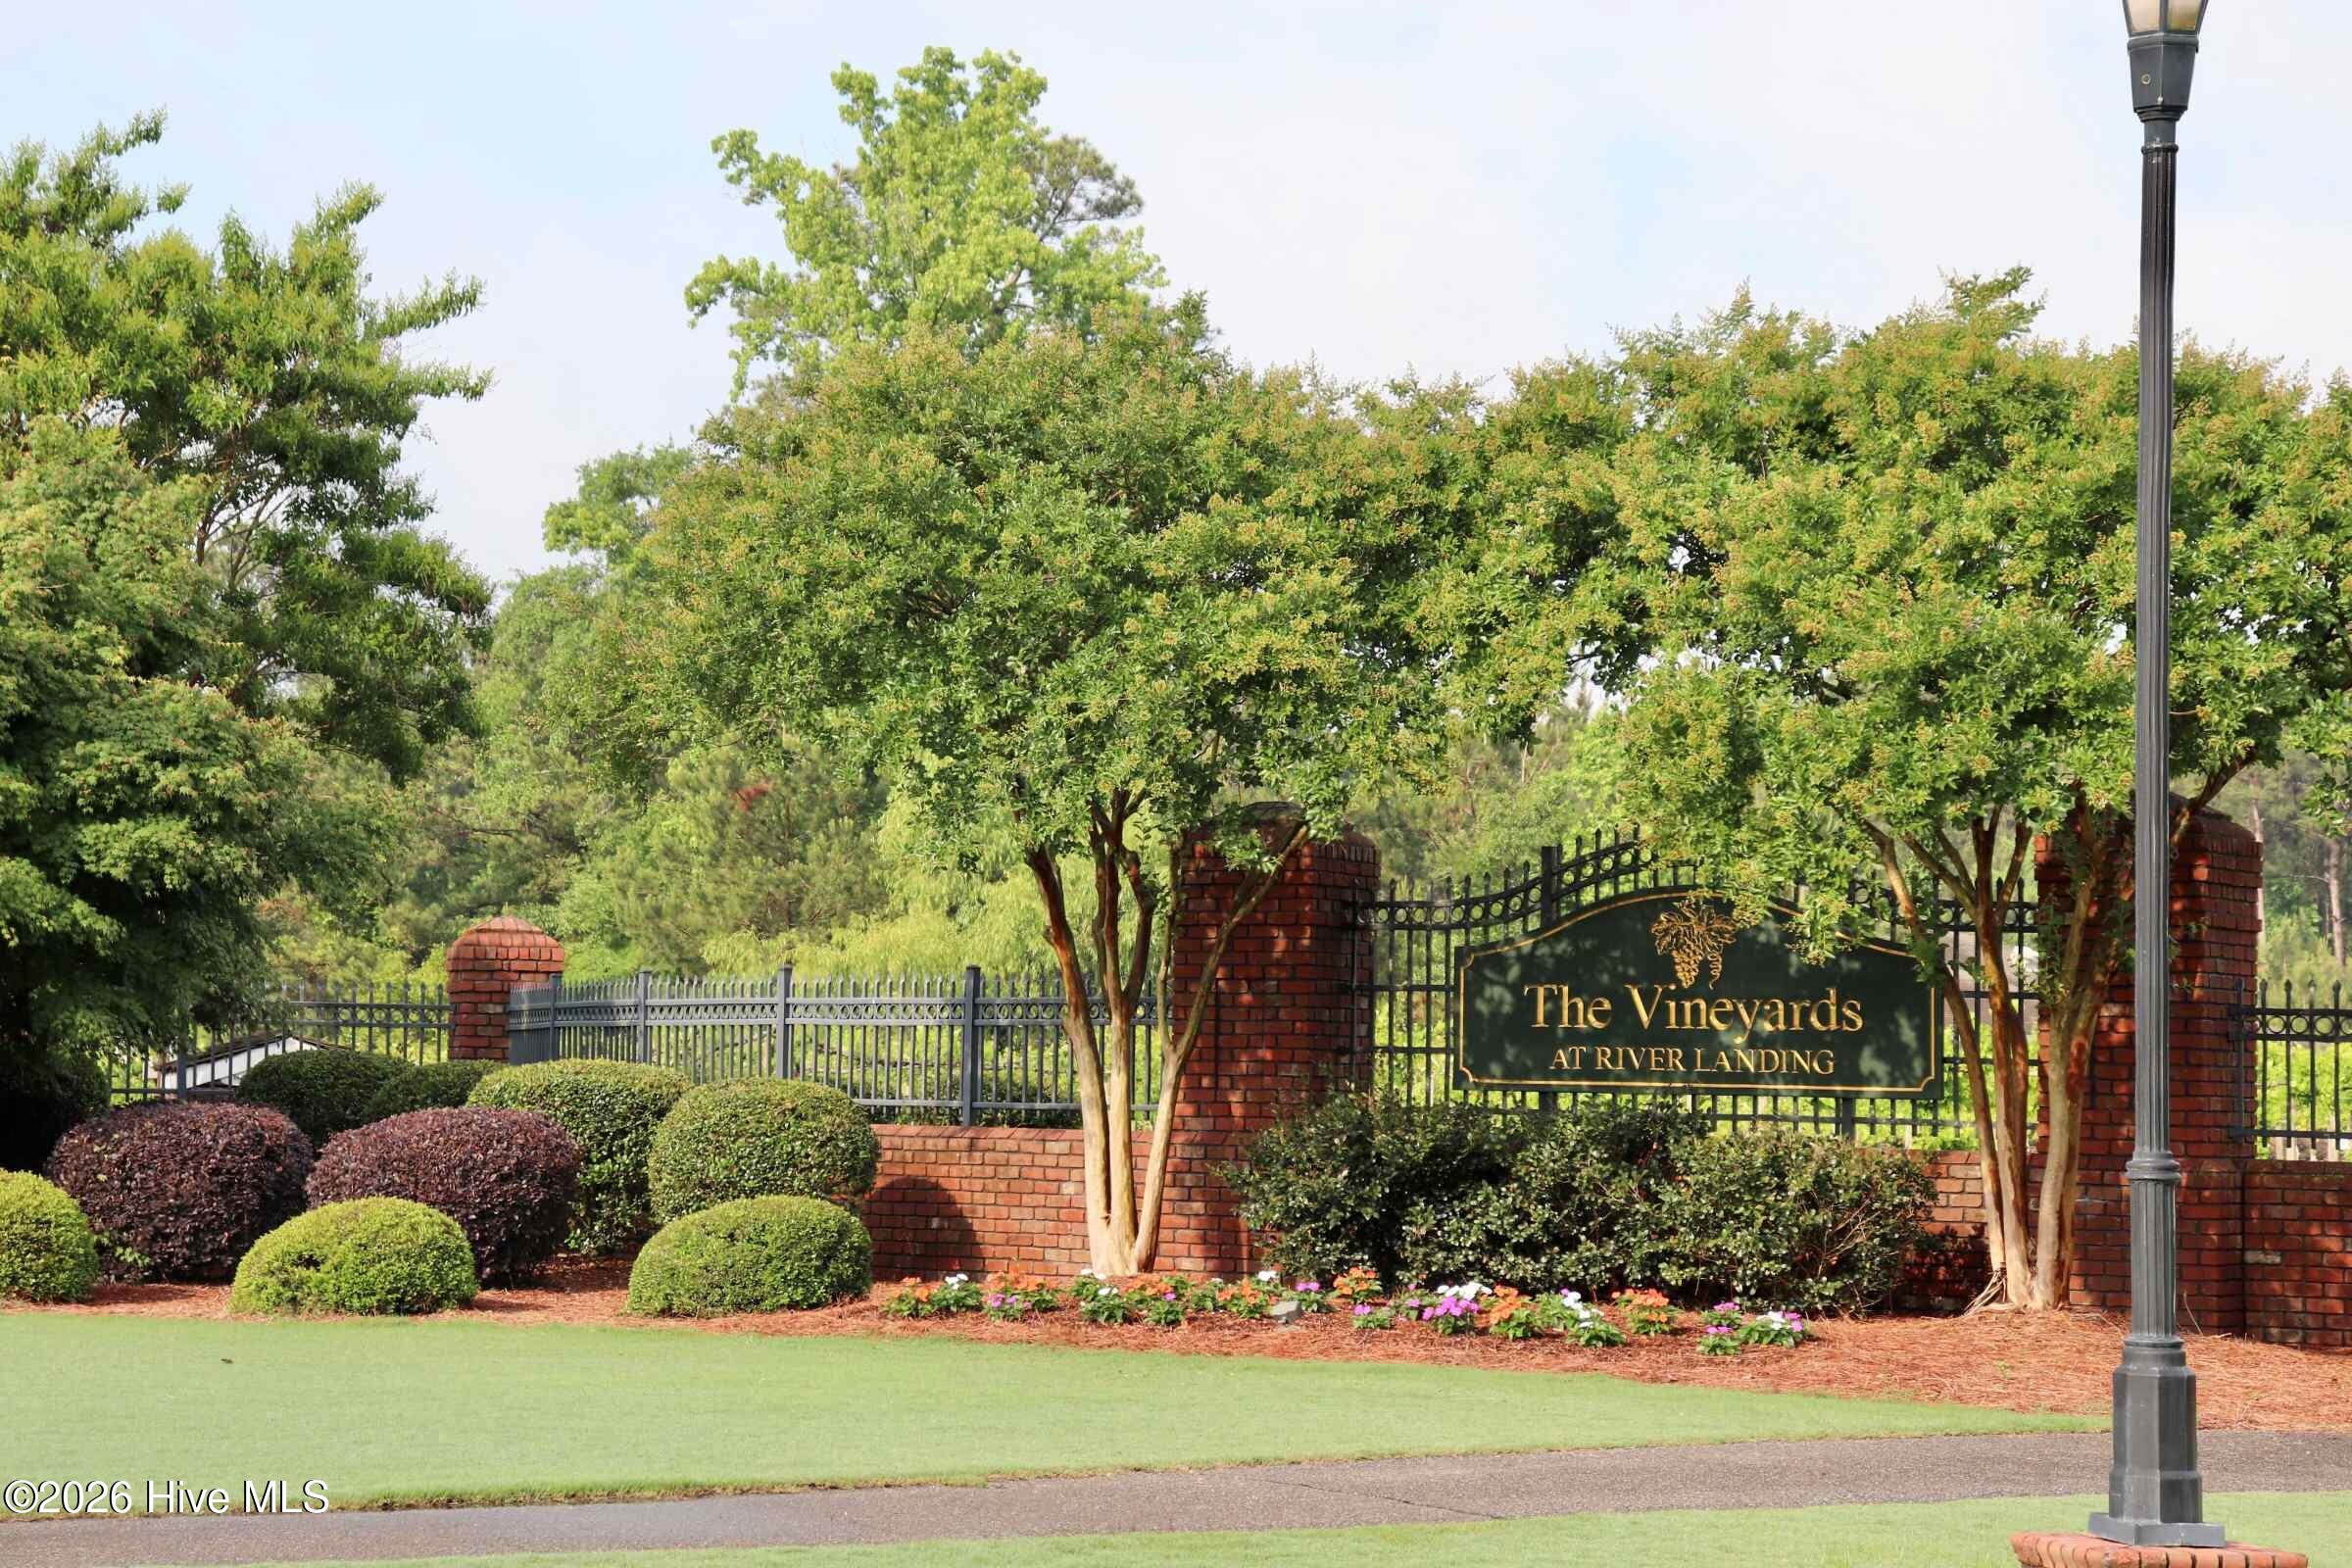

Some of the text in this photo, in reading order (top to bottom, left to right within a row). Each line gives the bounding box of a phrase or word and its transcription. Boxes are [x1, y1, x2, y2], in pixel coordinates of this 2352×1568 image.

[1524, 983, 1864, 1045] The Vineyards
[1549, 1046, 1836, 1075] AT RIVER LANDING
